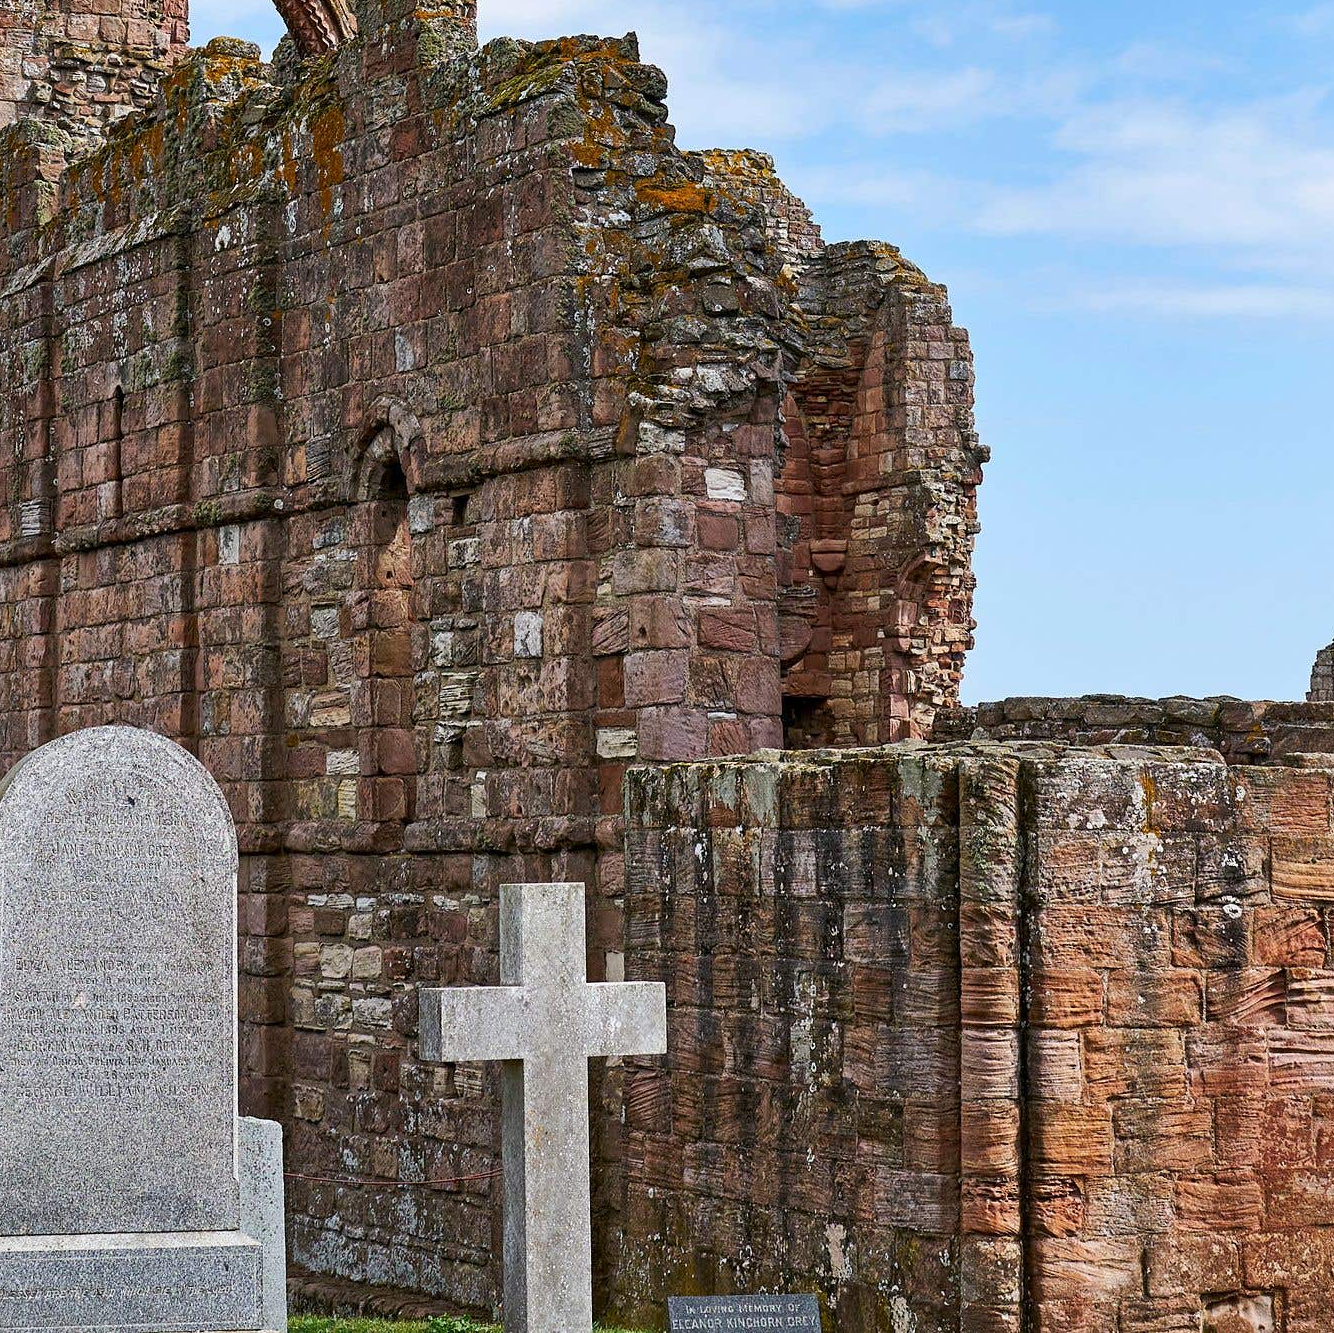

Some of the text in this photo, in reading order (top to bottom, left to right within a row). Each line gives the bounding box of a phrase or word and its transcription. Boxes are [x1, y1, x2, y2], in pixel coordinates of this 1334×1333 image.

[686, 1306, 695, 1314] IN
[700, 1306, 734, 1314] LOVING
[739, 1304, 781, 1313] MEMORY
[672, 1317, 815, 1330] ELEANOR KINGHORN GREY
